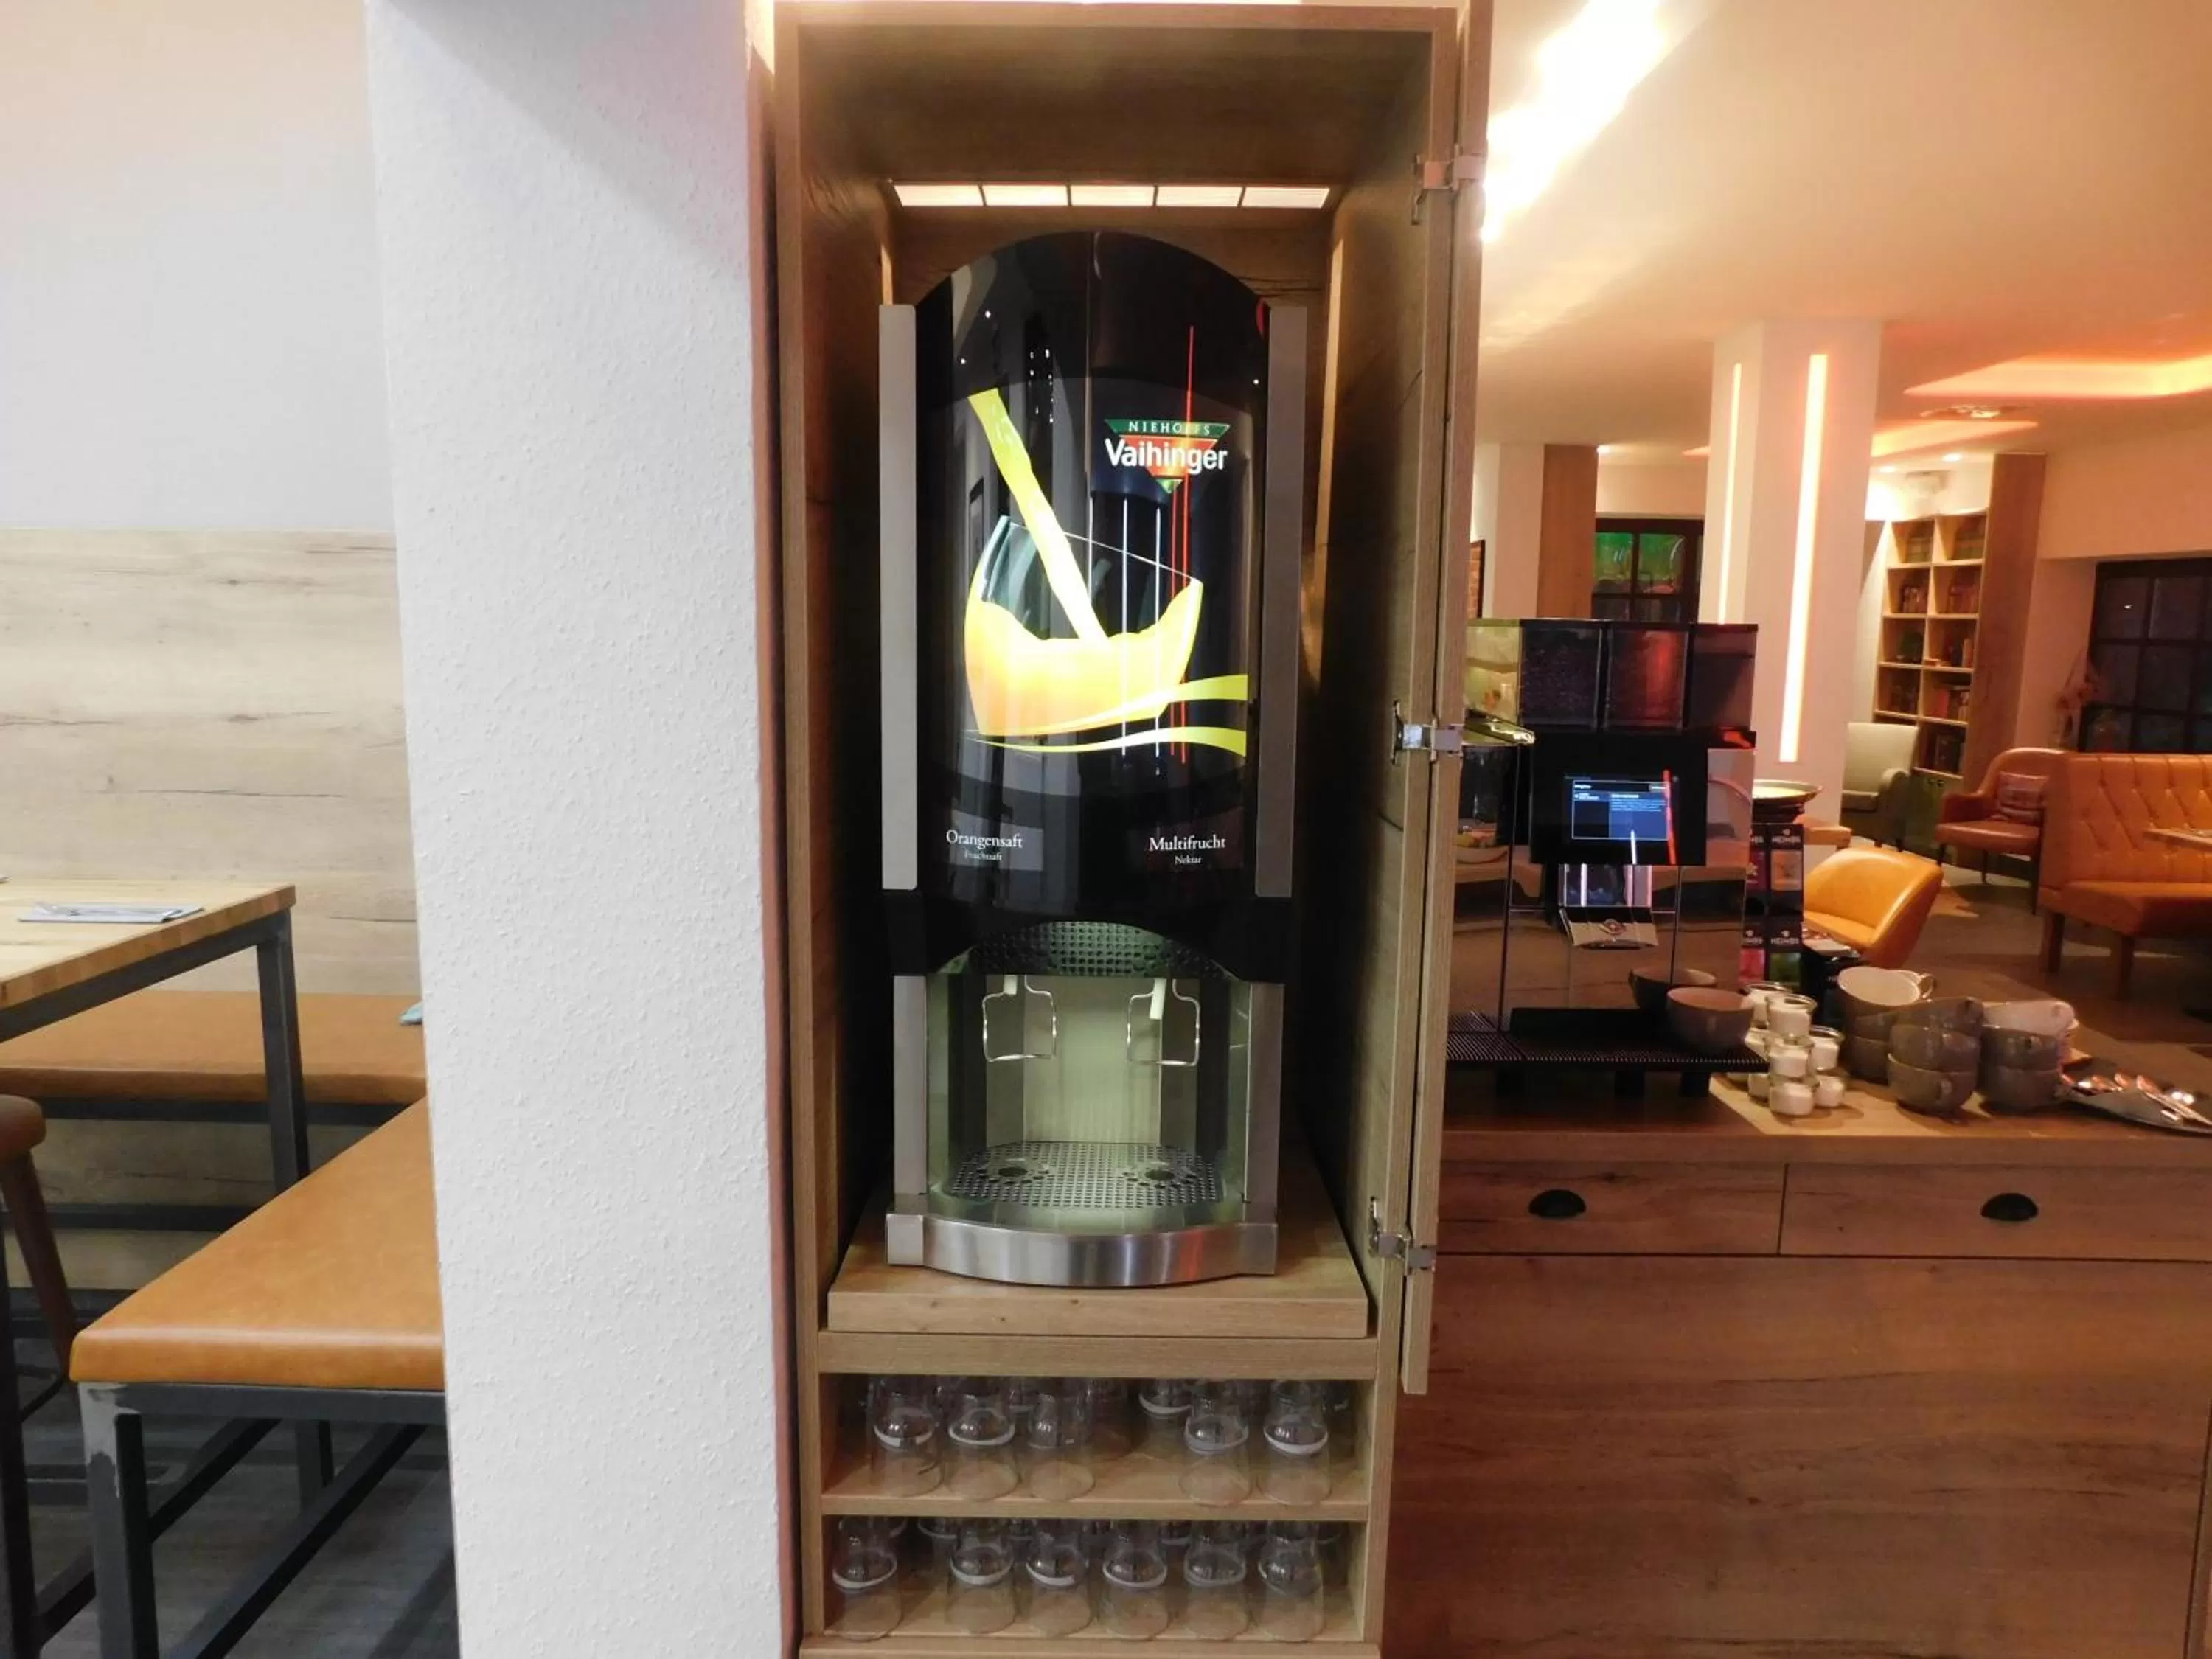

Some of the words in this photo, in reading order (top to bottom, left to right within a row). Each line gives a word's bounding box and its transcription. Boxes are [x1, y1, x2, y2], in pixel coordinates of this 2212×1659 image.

[1105, 437, 1228, 476] Vaihinger
[946, 829, 1023, 850] Orangensaft
[1149, 834, 1226, 852] Multifrucht
